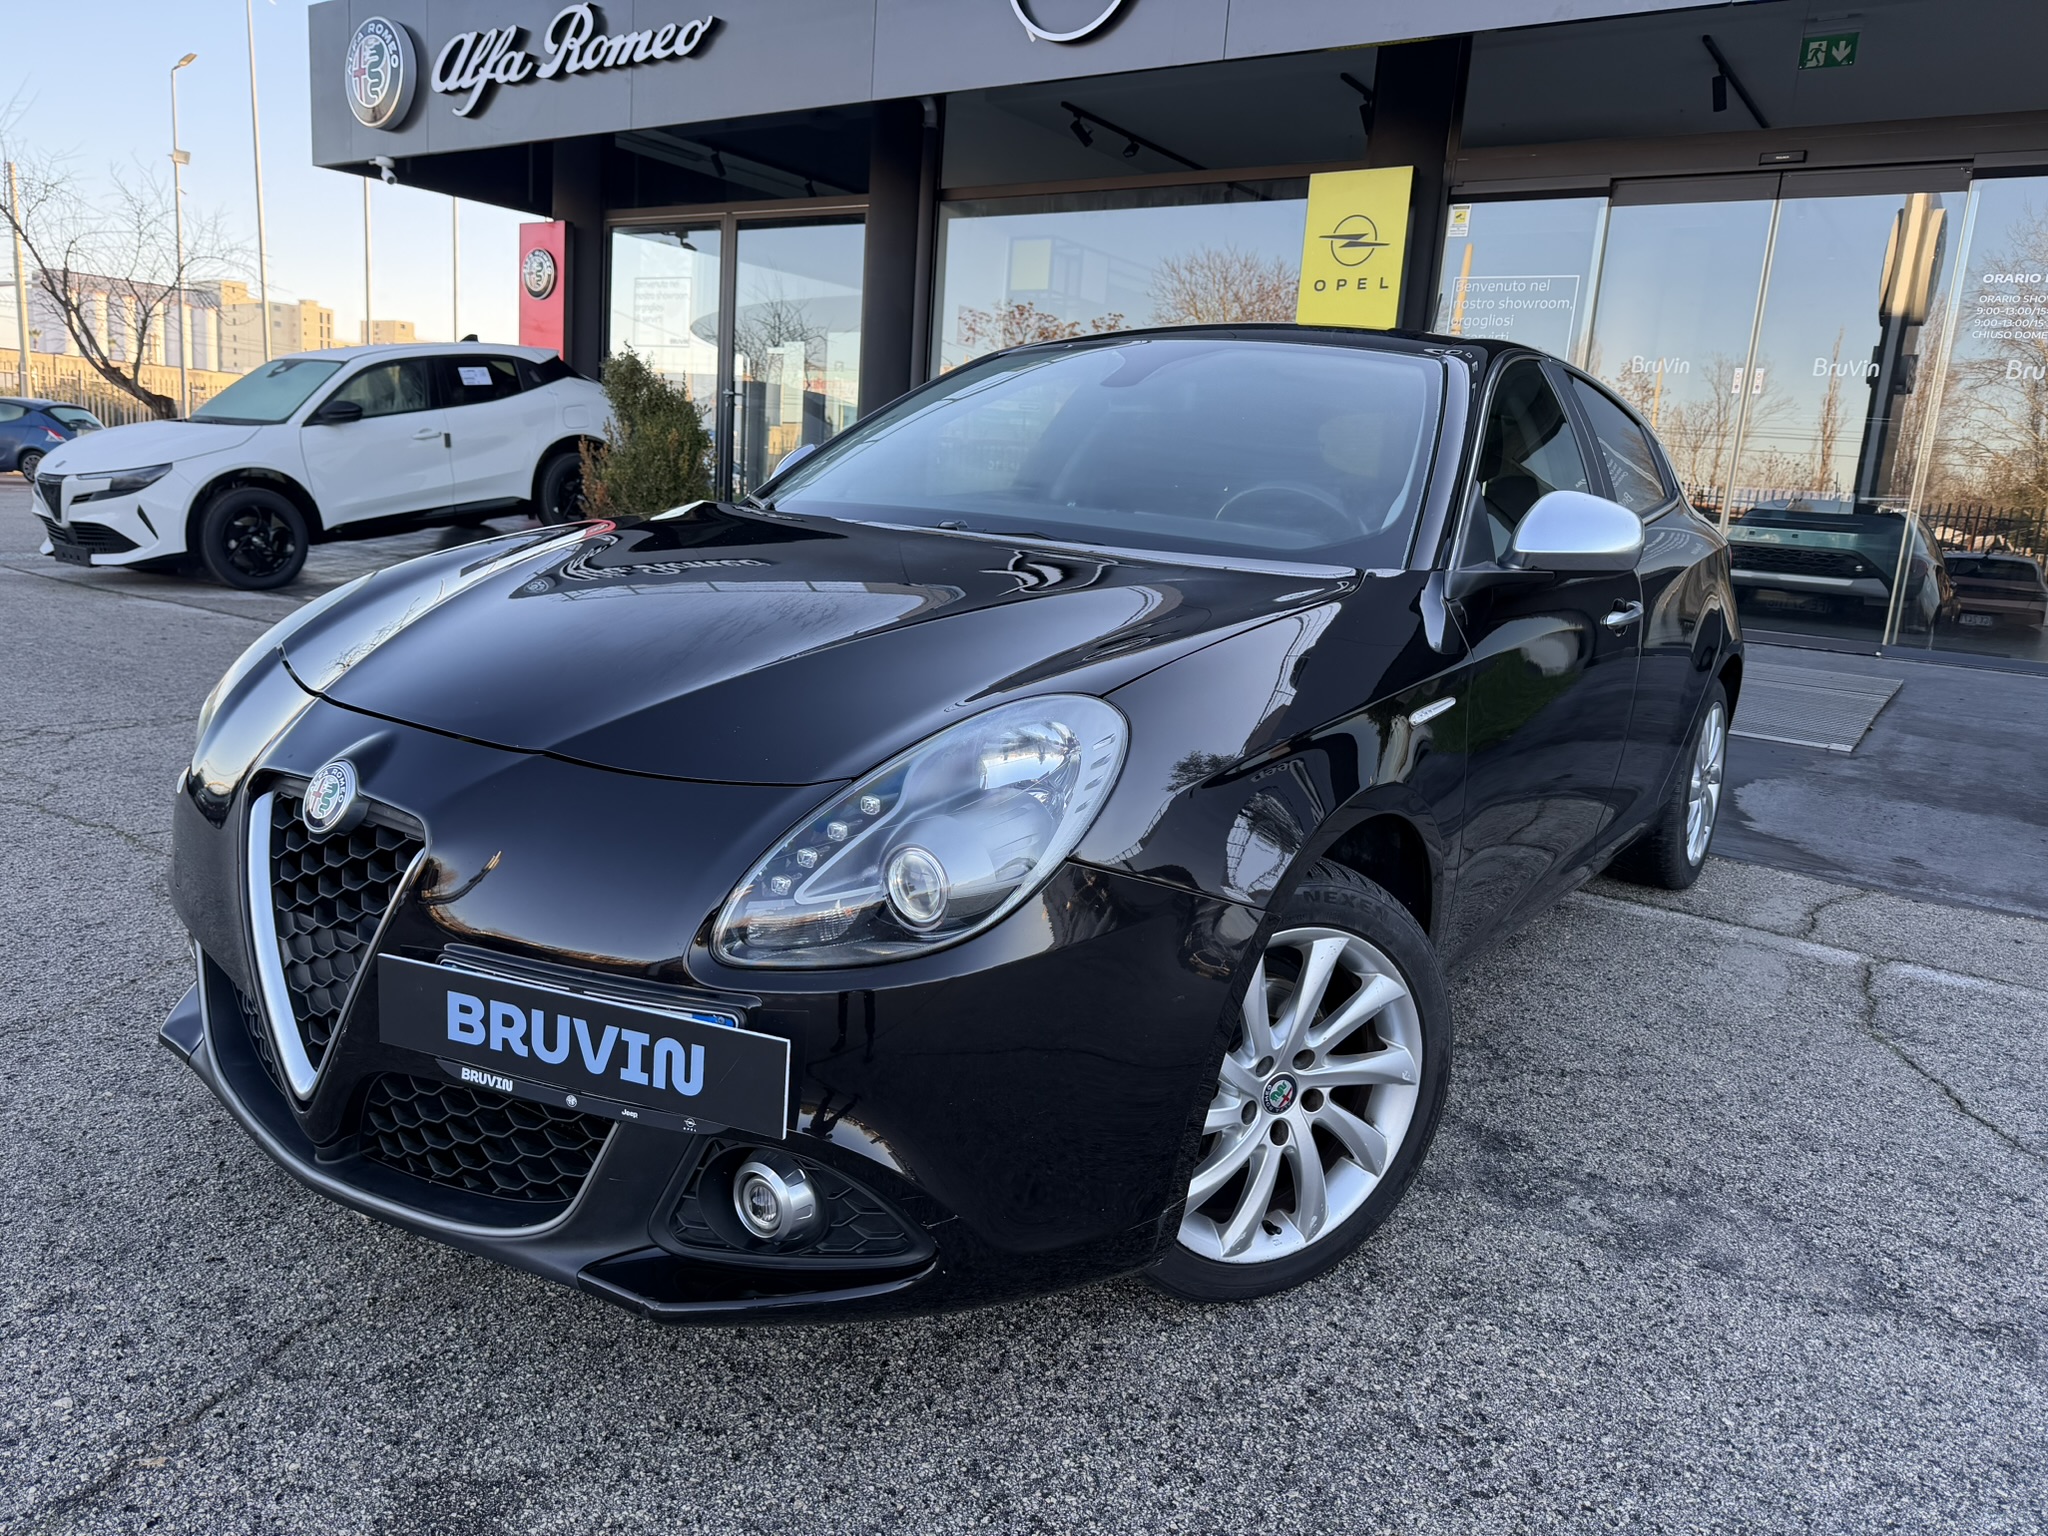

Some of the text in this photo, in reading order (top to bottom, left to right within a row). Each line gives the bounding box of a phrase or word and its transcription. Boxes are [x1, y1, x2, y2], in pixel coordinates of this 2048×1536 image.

[367, 23, 399, 68] ROMEO
[431, 2, 718, 117] Alfa Romeo
[1313, 277, 1389, 292] OPEL
[1455, 279, 1551, 293] Benvenuto nel
[1982, 273, 2042, 284] ORARIO
[1453, 297, 1574, 311] nostro showroom,
[1979, 295, 2021, 304] ORARIO
[1450, 314, 1515, 329] orgogliosi
[1971, 330, 2012, 340] CHIUSO
[1631, 355, 1690, 375] BruVin
[1812, 357, 1881, 378] BruVin
[331, 768, 346, 803] ROMEO
[1302, 889, 1391, 921] NEXEN
[446, 990, 706, 1097] BRUVIN
[461, 1066, 514, 1092] BRUVIN
[621, 1108, 639, 1119] Jeep
